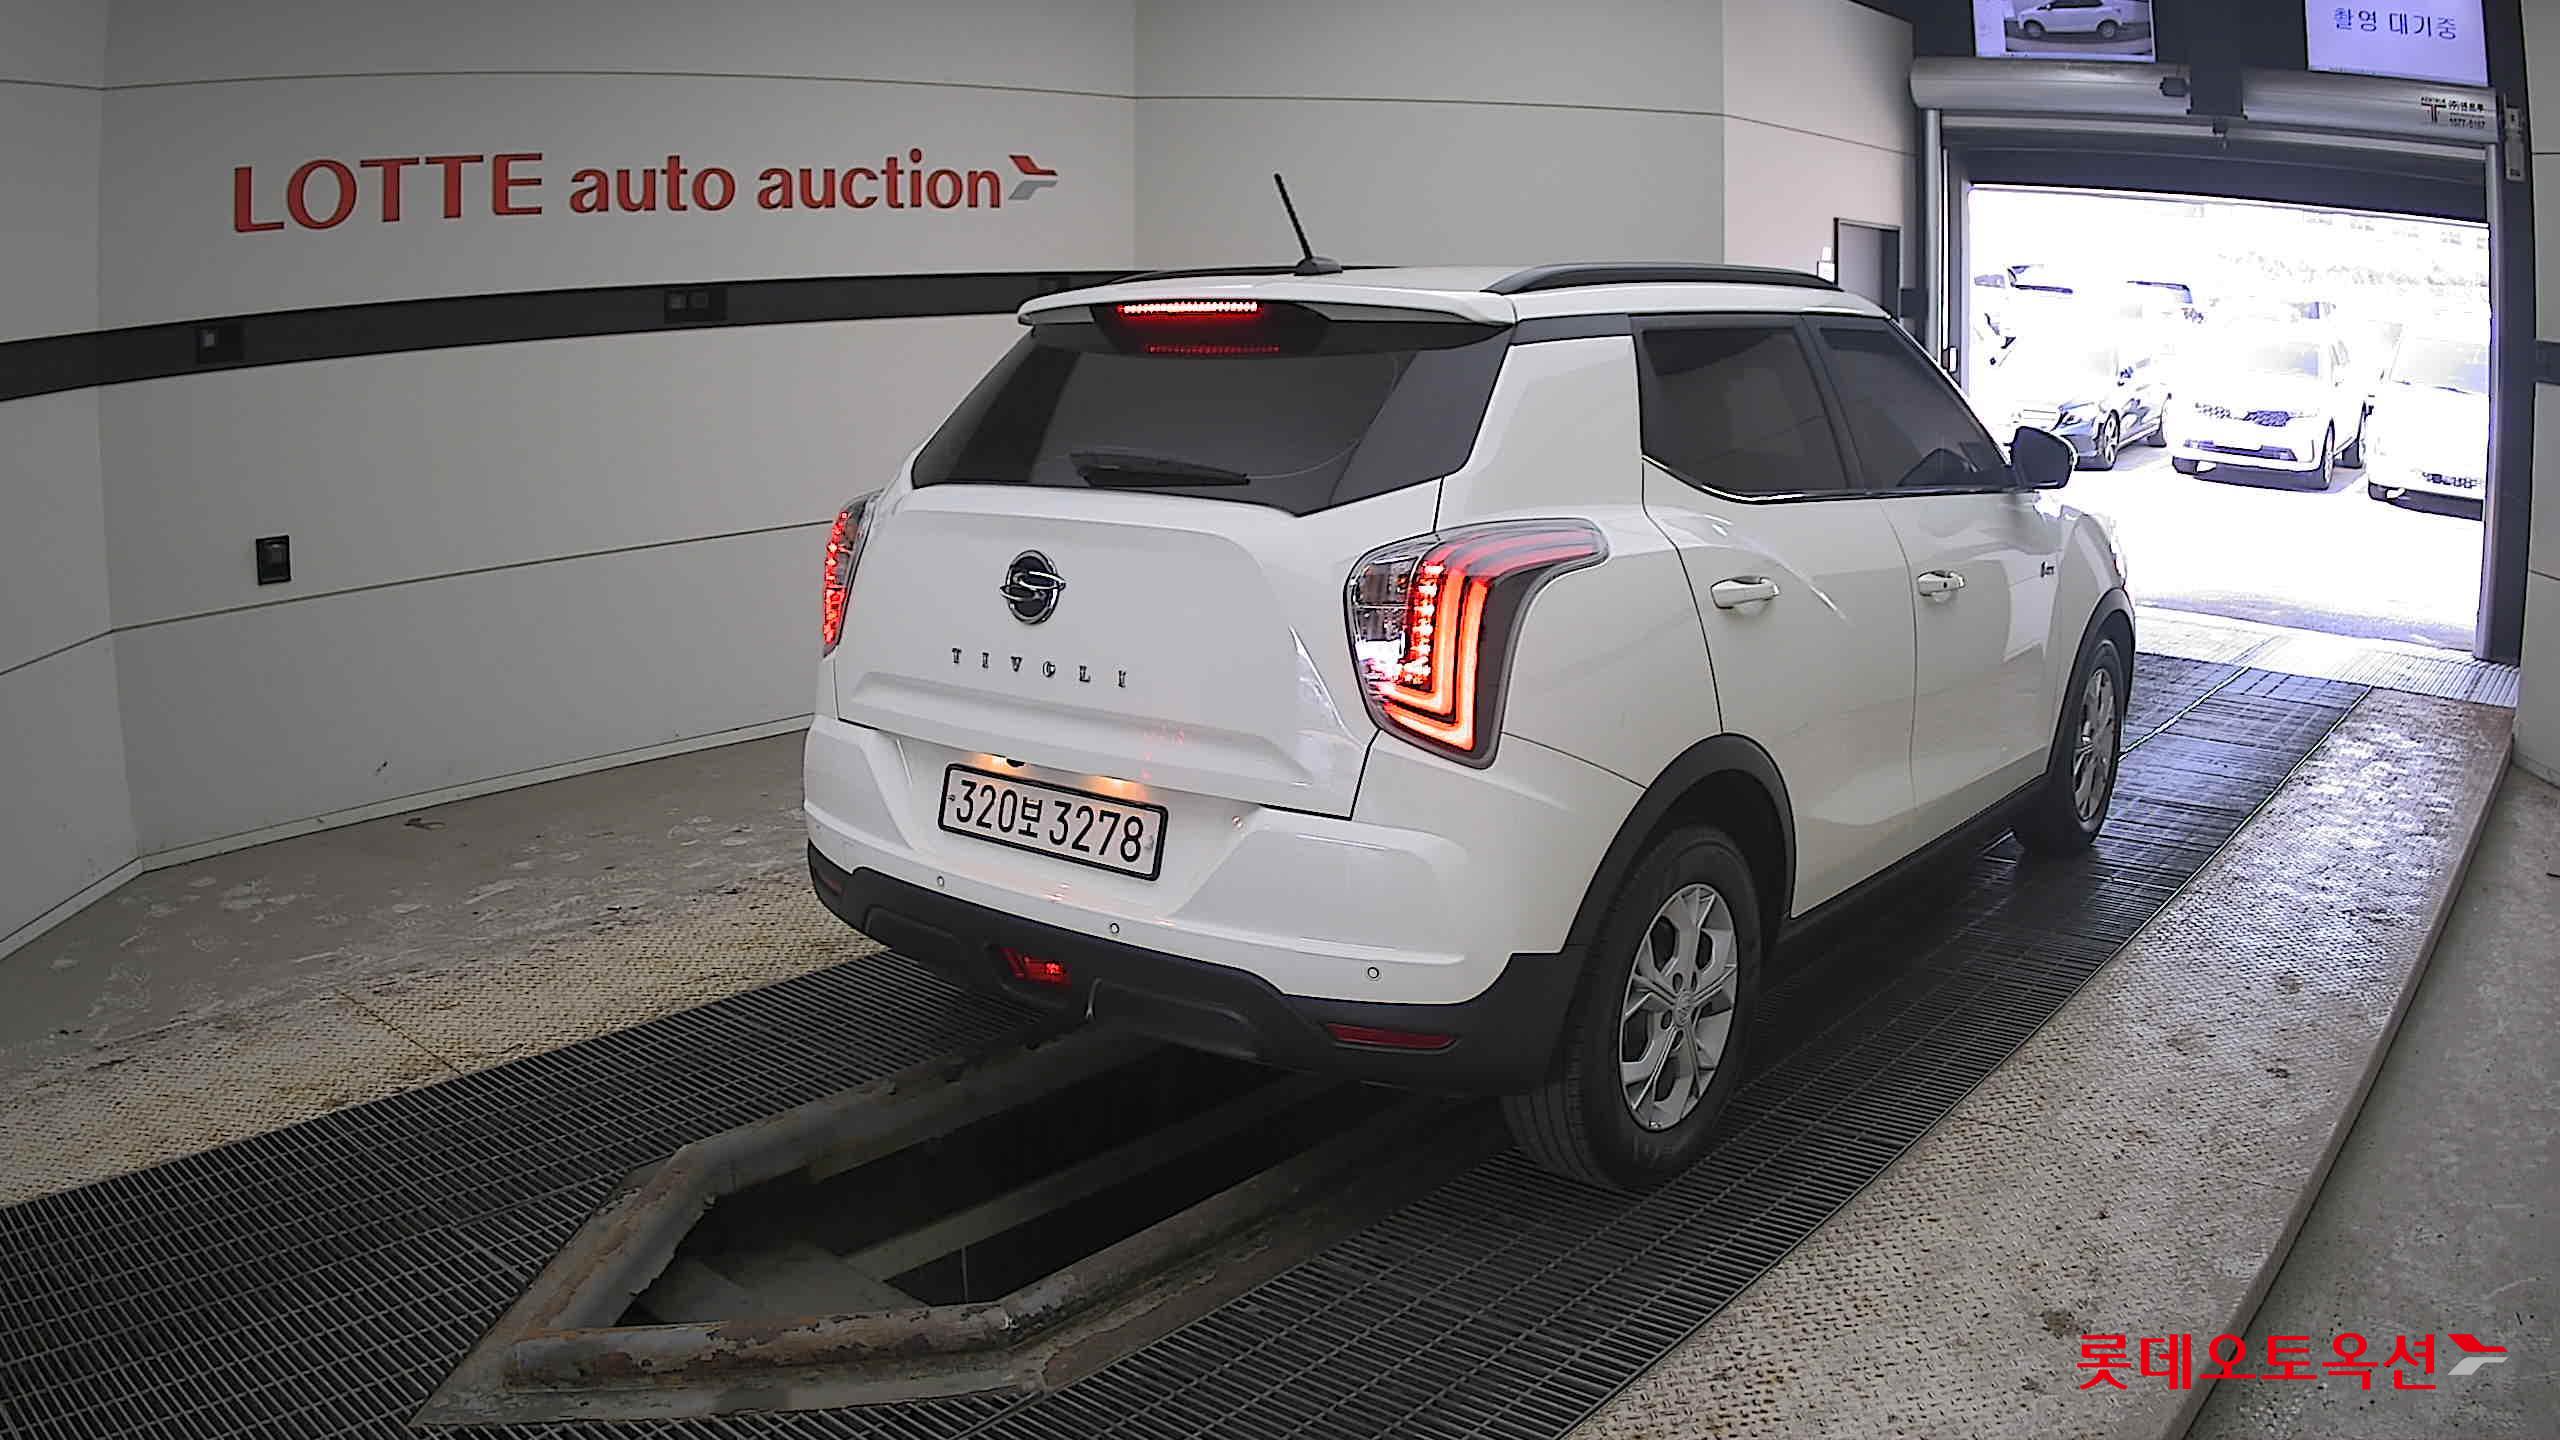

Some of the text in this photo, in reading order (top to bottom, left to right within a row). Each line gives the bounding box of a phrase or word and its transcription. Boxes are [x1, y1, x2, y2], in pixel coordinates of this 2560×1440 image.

[2389, 12, 2457, 41] 대기중
[235, 150, 1003, 233] LOTTE auto auction
[952, 647, 1127, 689] TIVOLI
[955, 779, 1144, 863] 320보 3278
